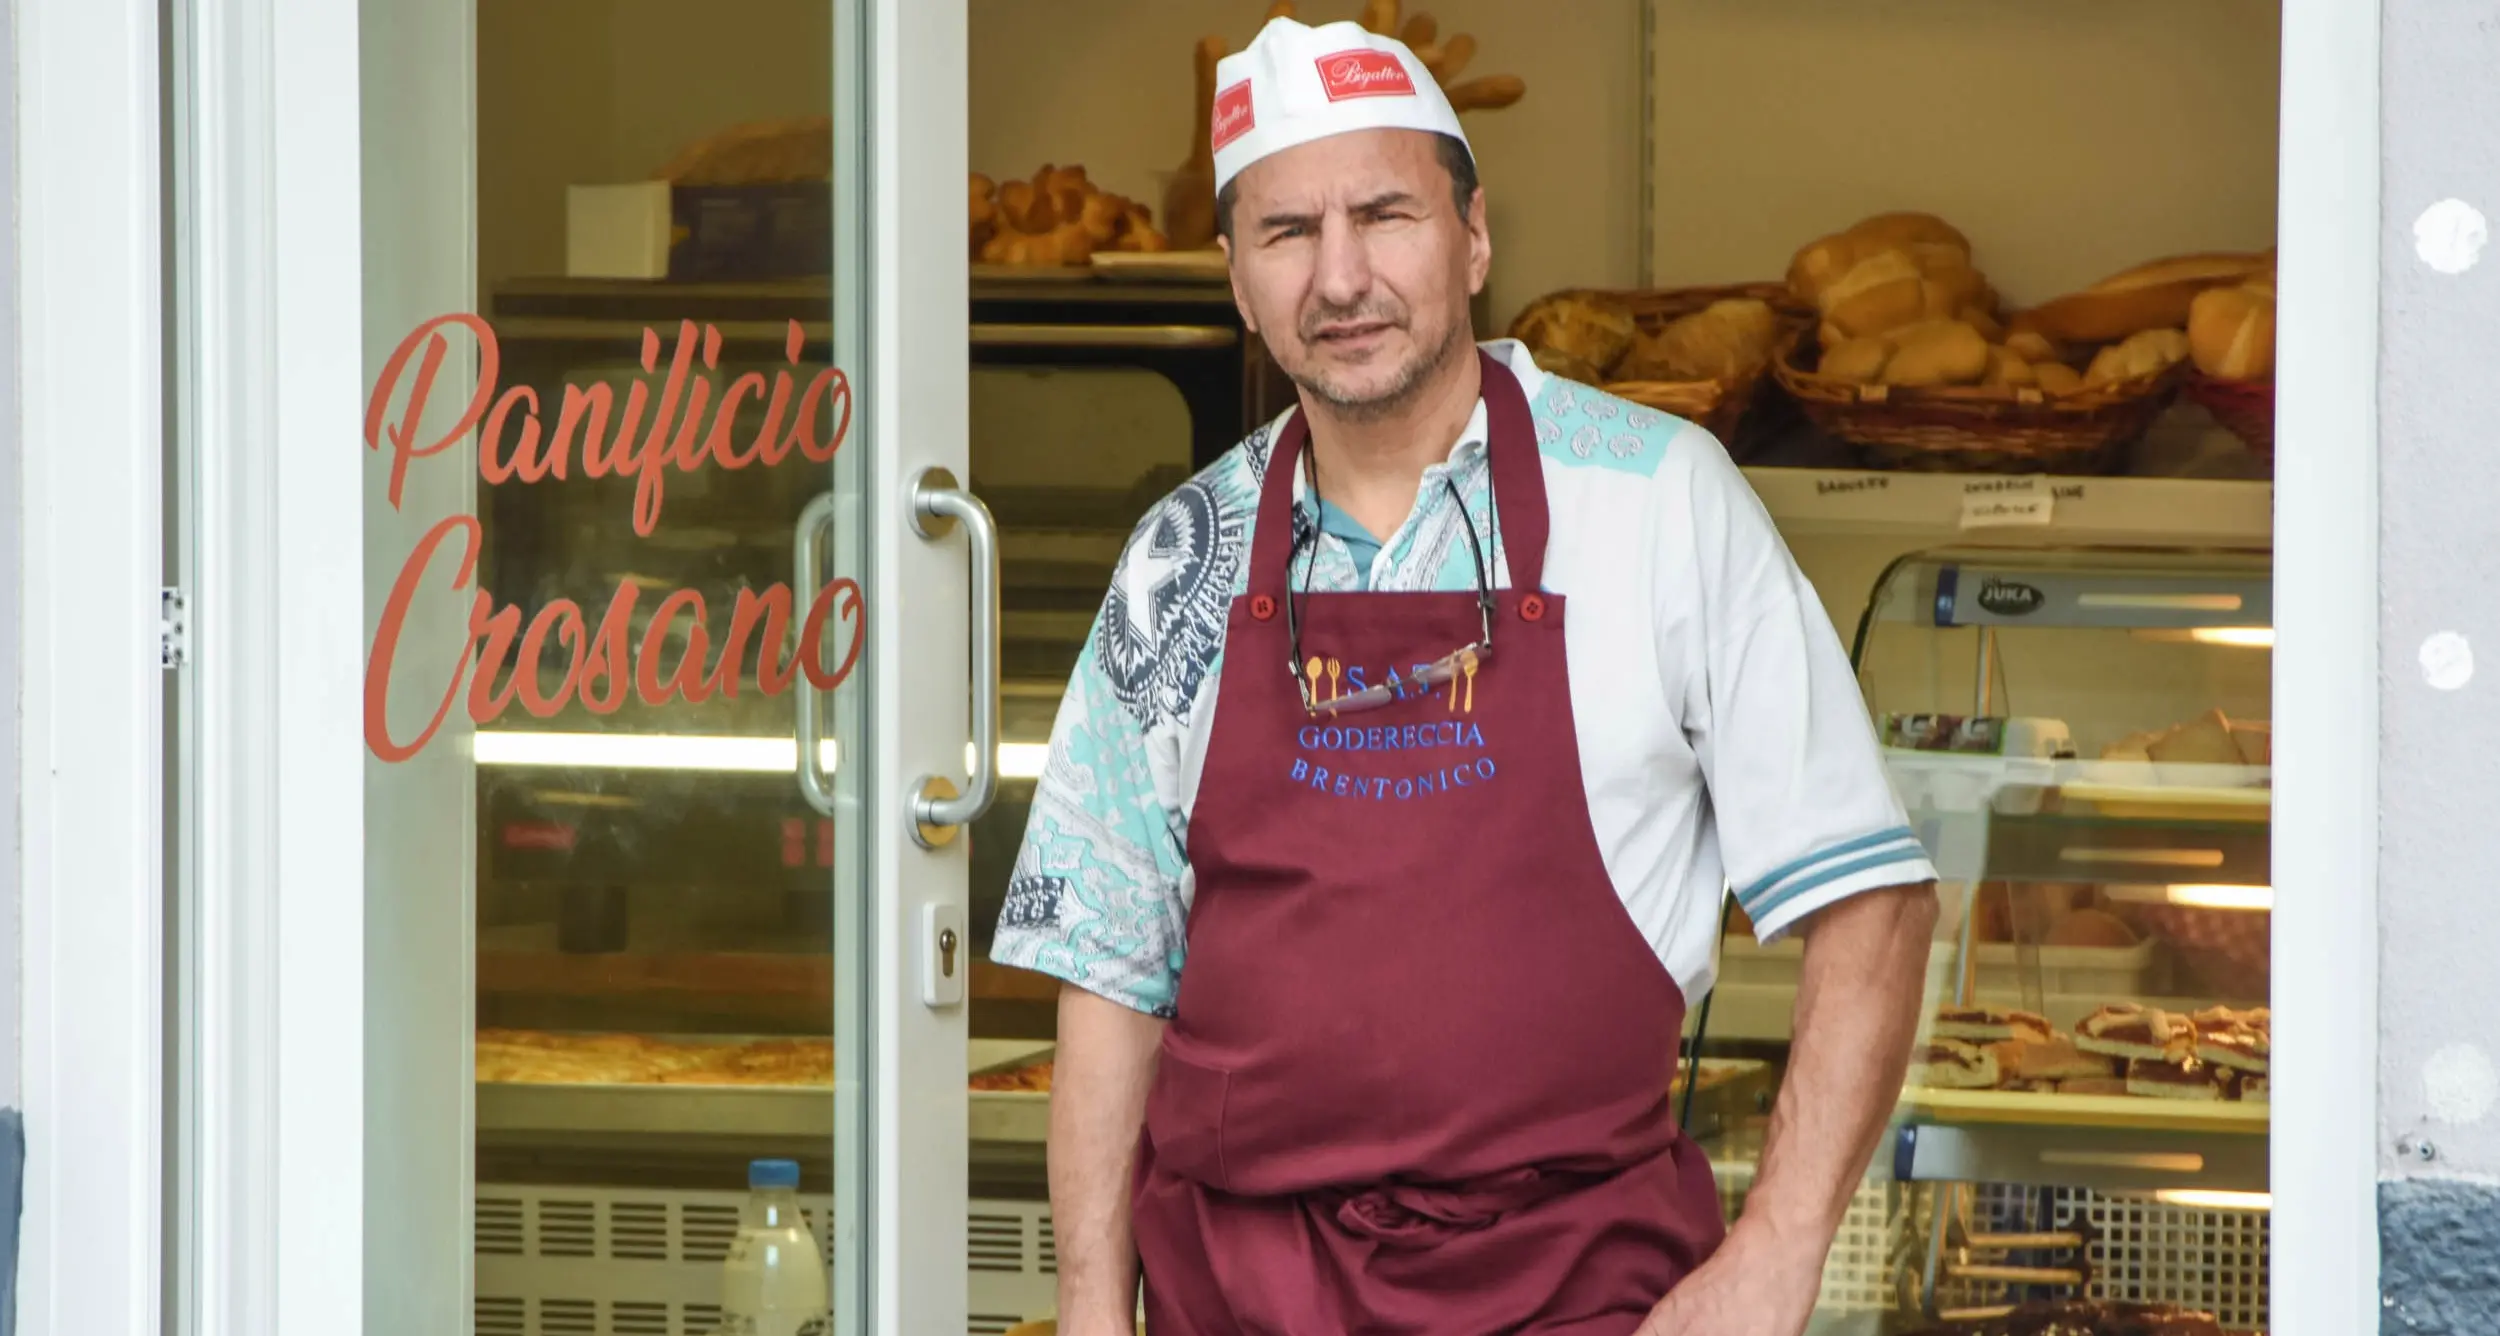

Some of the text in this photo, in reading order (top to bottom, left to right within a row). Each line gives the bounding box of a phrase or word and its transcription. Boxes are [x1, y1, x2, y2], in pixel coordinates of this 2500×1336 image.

[363, 312, 852, 537] Panificio
[1984, 586, 2033, 602] JUKA
[363, 513, 865, 763] Crosano
[1298, 721, 1486, 751] GODERECCIA
[1290, 757, 1496, 801] BRENTONICO
